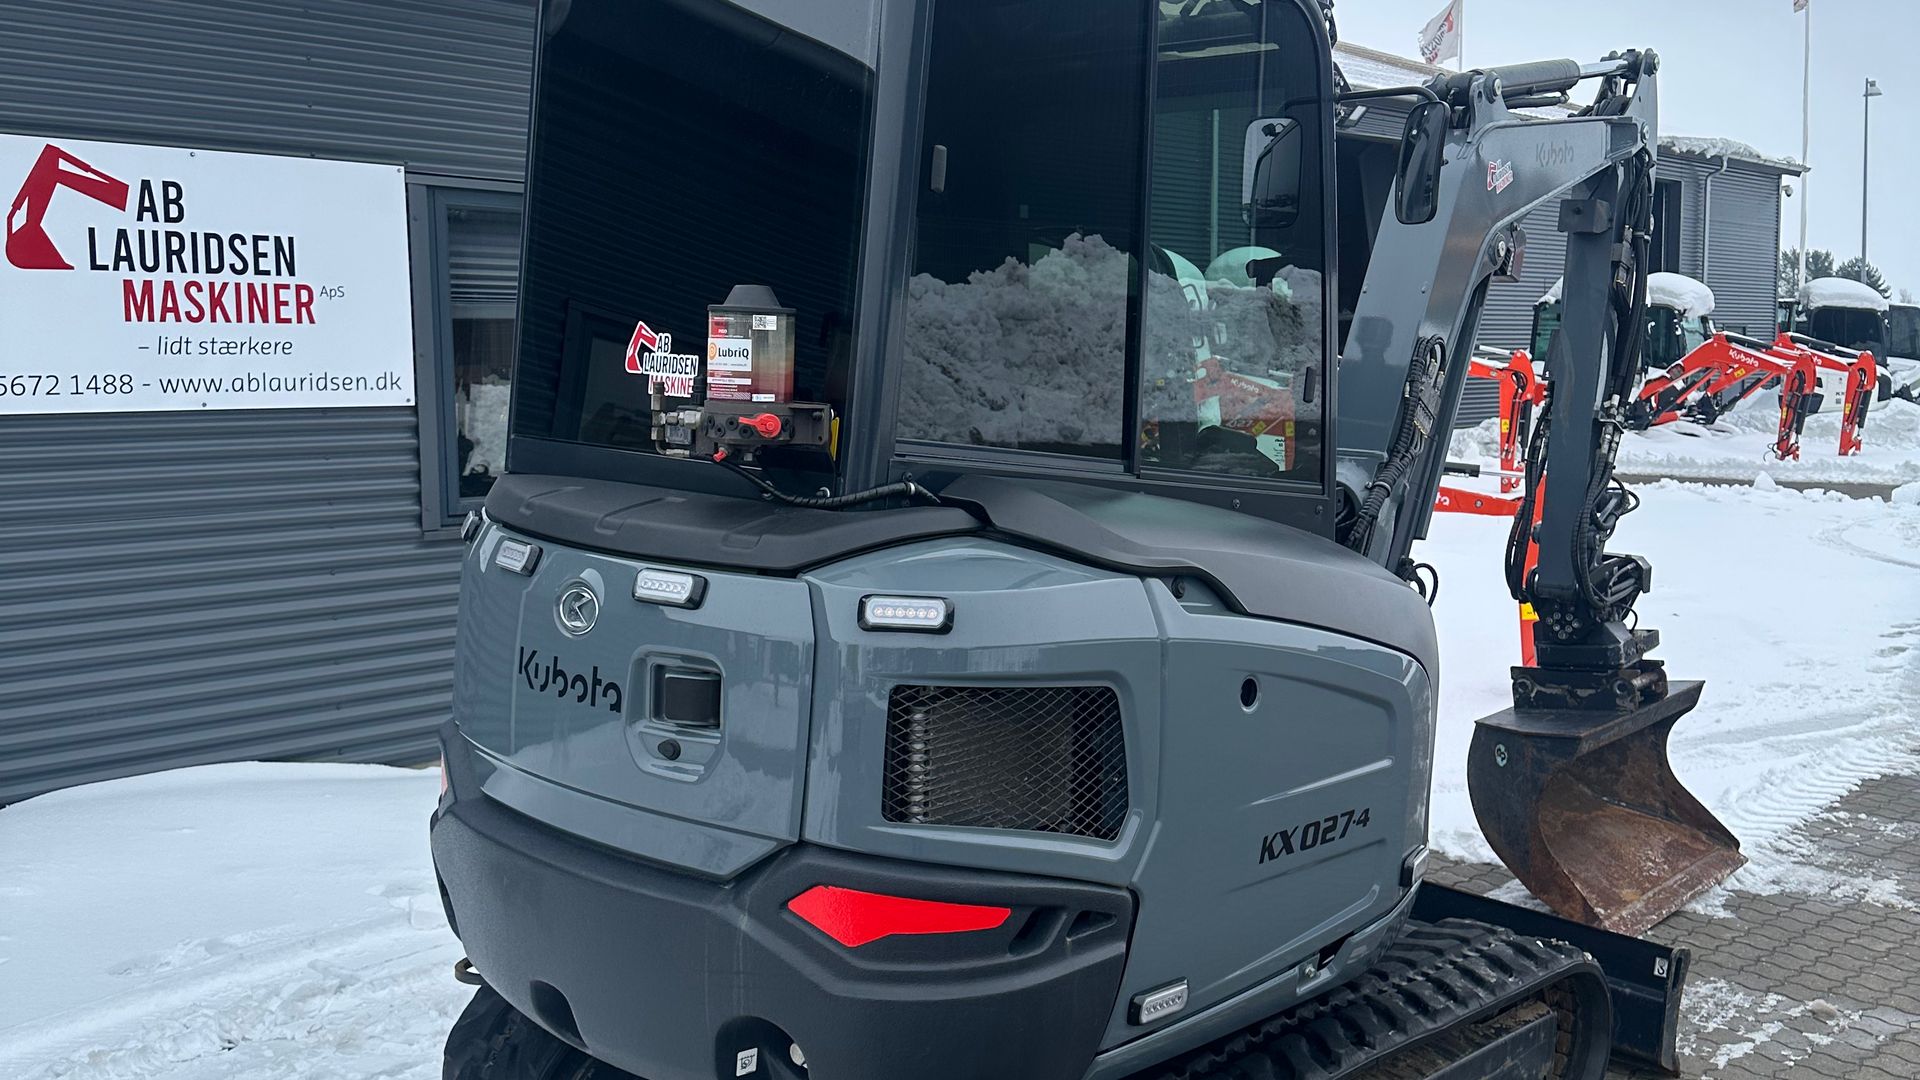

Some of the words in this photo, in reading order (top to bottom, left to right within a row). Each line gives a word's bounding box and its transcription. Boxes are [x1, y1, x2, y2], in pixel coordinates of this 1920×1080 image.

[137, 179, 185, 223] AB
[88, 226, 296, 277] LAURIDSEN
[122, 279, 316, 325] MASKINER
[319, 285, 345, 301] ApS
[157, 336, 192, 356] lidt
[198, 337, 293, 356] stærkere
[656, 335, 670, 353] AB
[718, 347, 749, 360] LubriQ
[644, 355, 697, 375] LAURIDSEN
[1728, 349, 1760, 368] Kubota
[70, 374, 134, 395] 1488
[159, 372, 402, 393] www.ablauridsen.dk
[518, 646, 622, 713] Kubota
